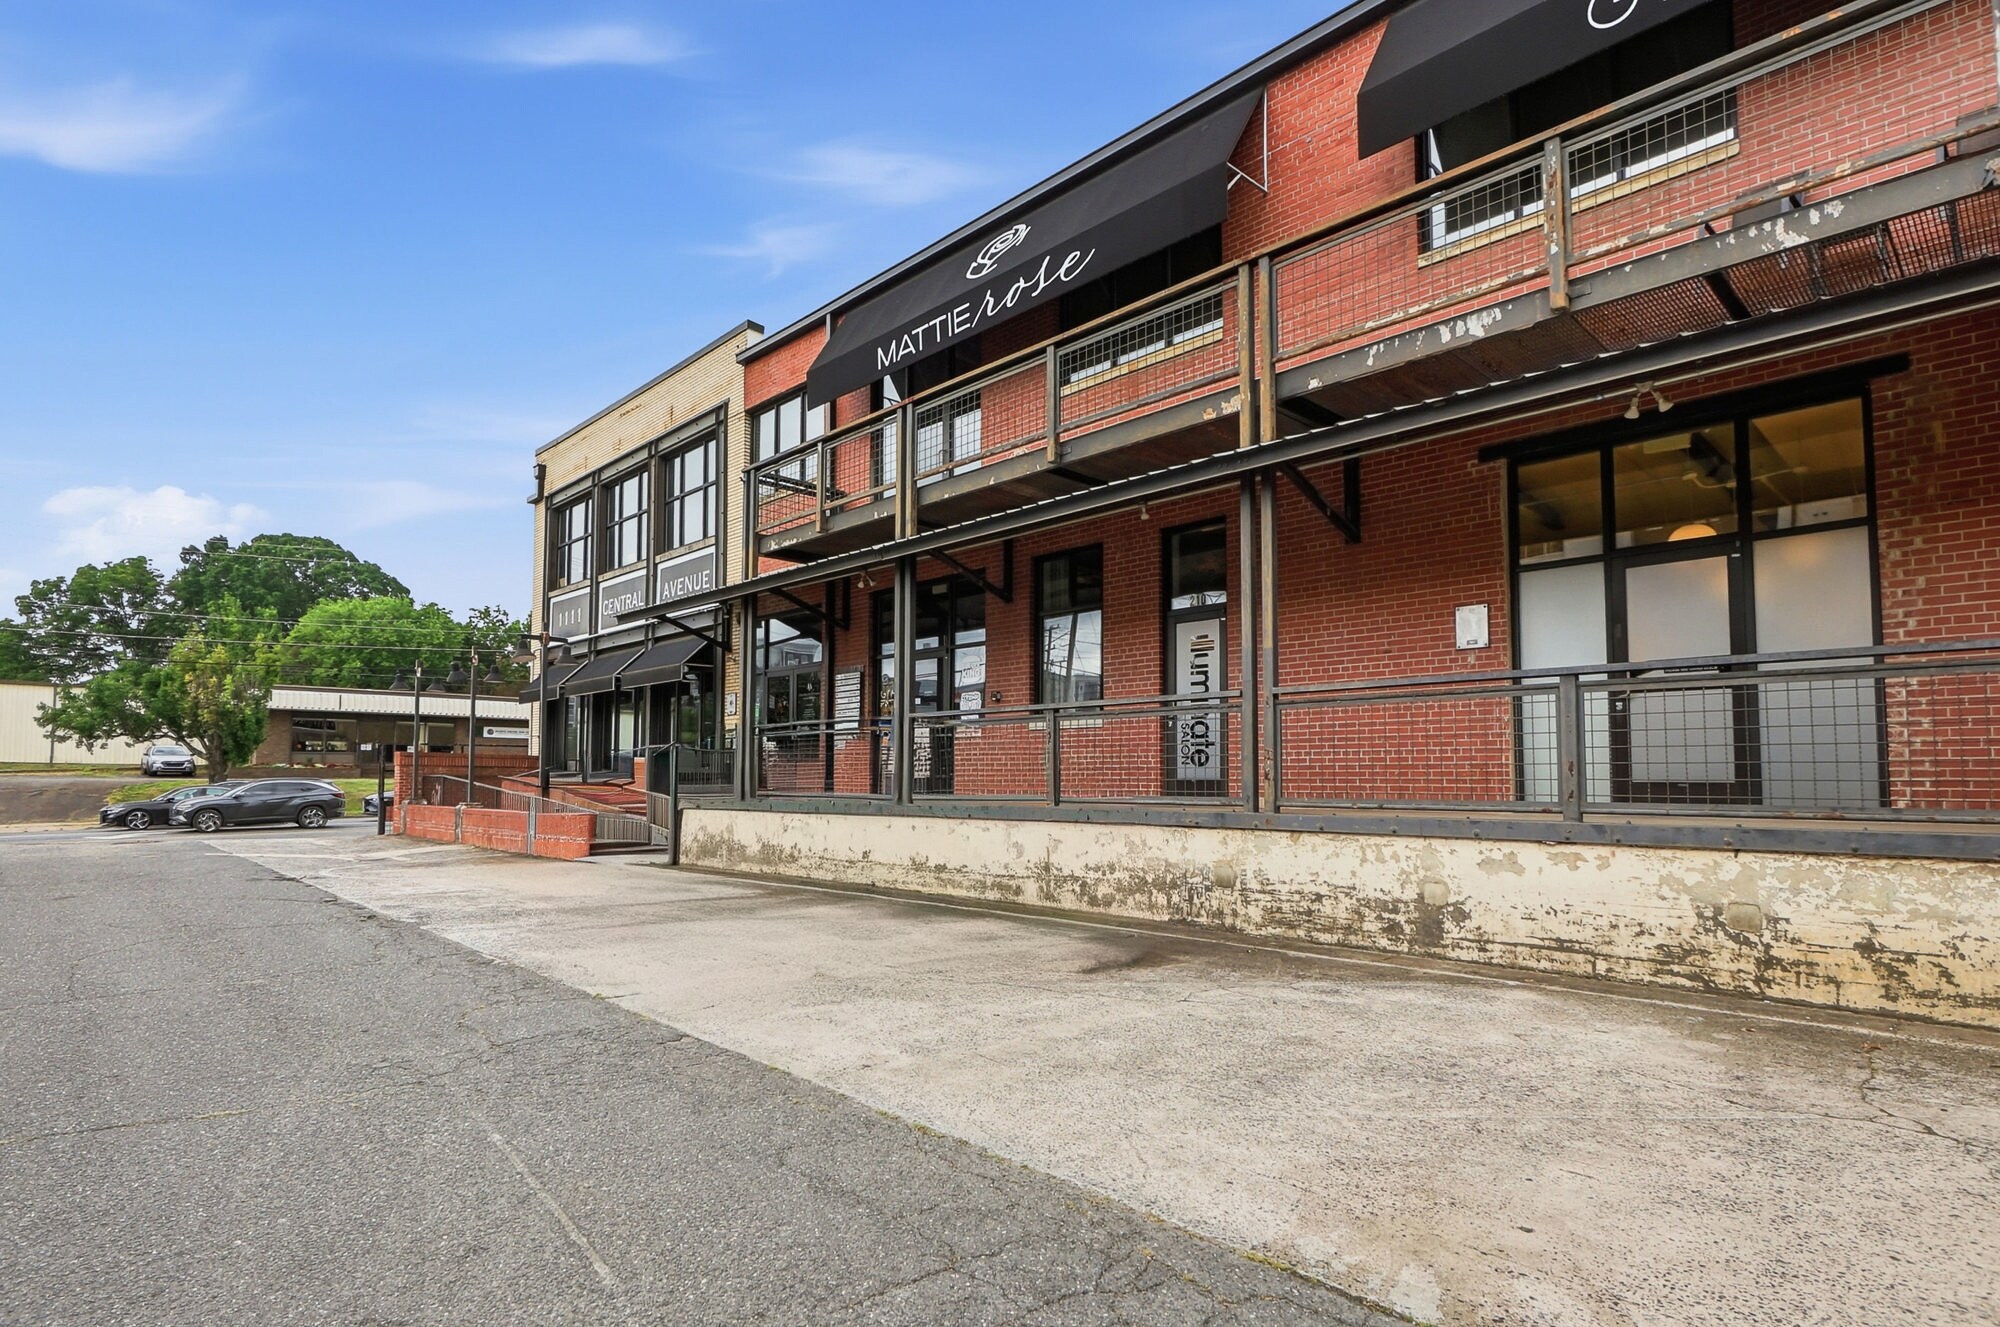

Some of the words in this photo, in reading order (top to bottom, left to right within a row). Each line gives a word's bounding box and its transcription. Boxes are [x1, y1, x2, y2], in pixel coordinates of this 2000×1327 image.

[877, 302, 970, 370] MATTIE
[971, 248, 1096, 328] rose
[559, 607, 581, 628] 1111
[602, 590, 644, 615] CENTRAL
[662, 569, 711, 600] AVENUE
[1190, 594, 1206, 606] 210
[1181, 723, 1190, 765] SALON
